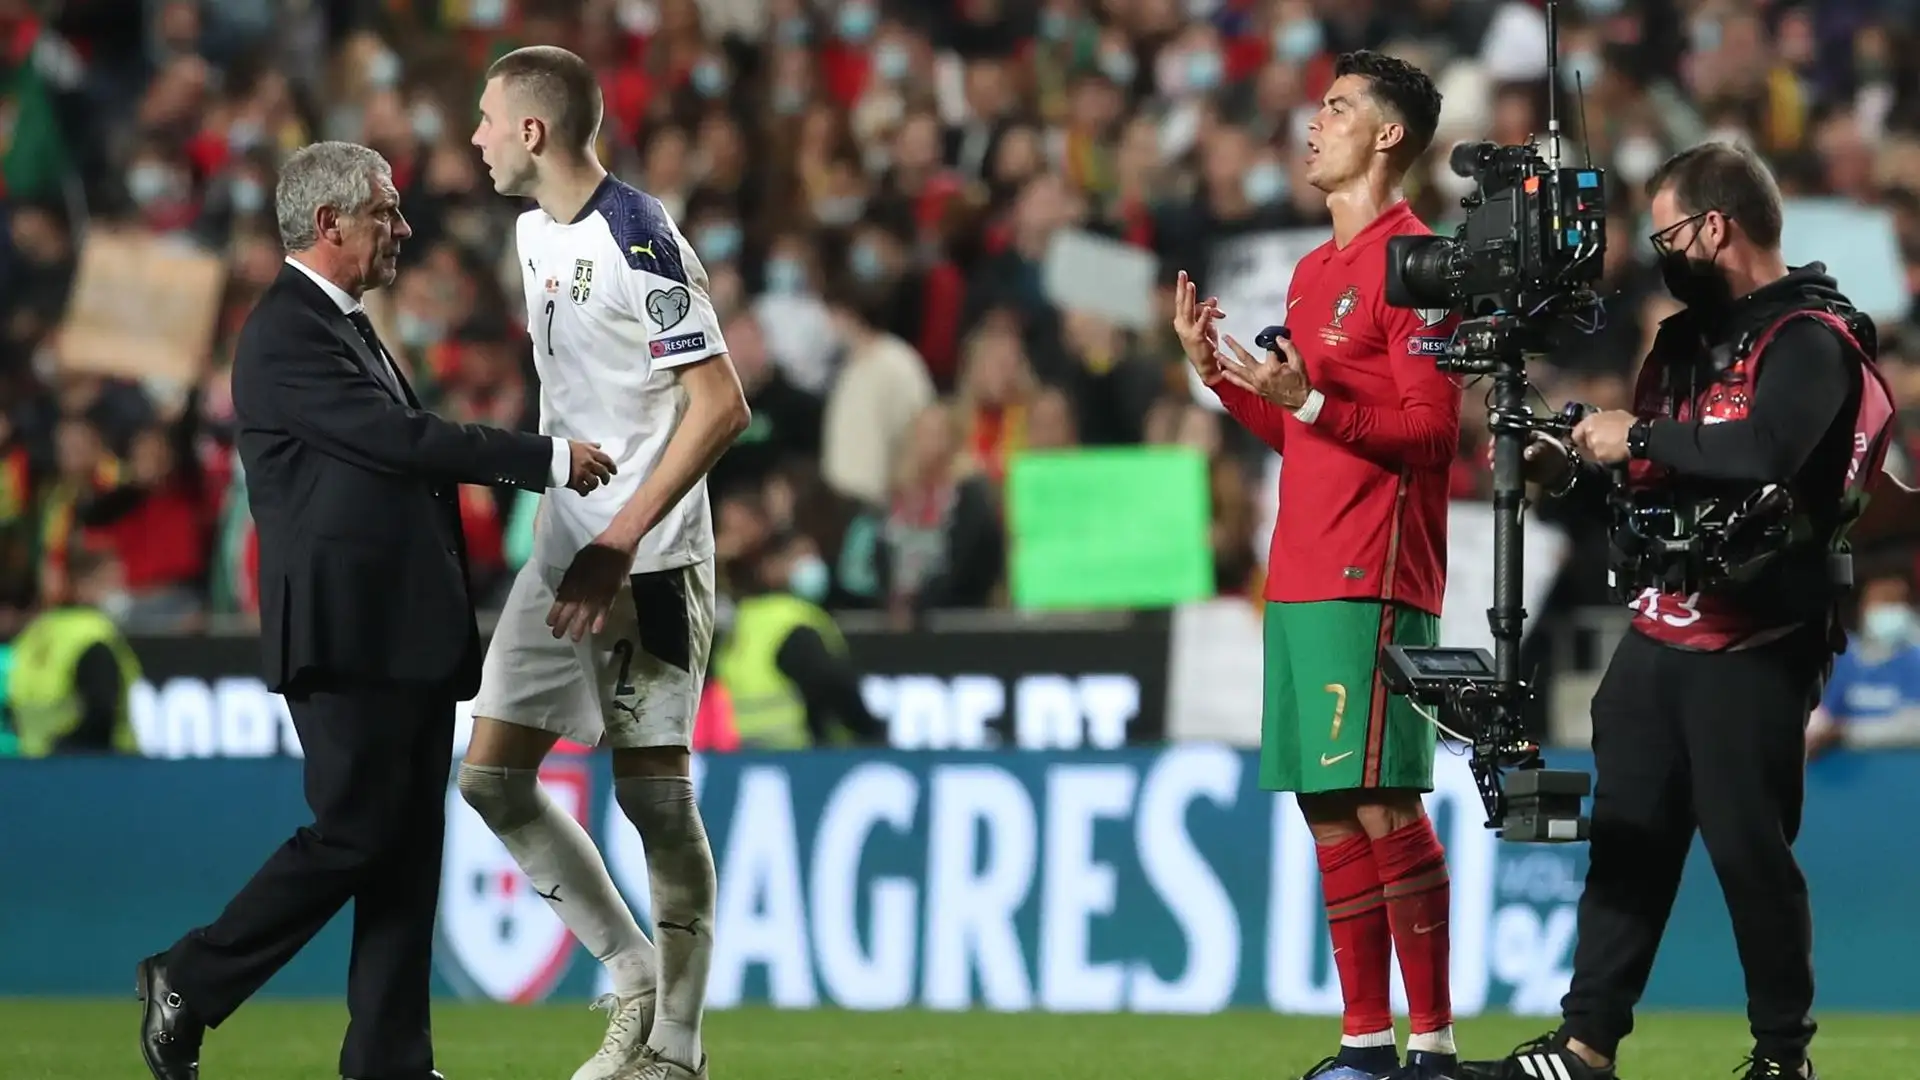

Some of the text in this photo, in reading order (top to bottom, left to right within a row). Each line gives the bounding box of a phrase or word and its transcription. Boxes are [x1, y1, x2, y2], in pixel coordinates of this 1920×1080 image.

[664, 336, 704, 352] RESPECT
[1422, 341, 1451, 351] RESP
[613, 638, 636, 696] 2
[1323, 683, 1347, 740] 7
